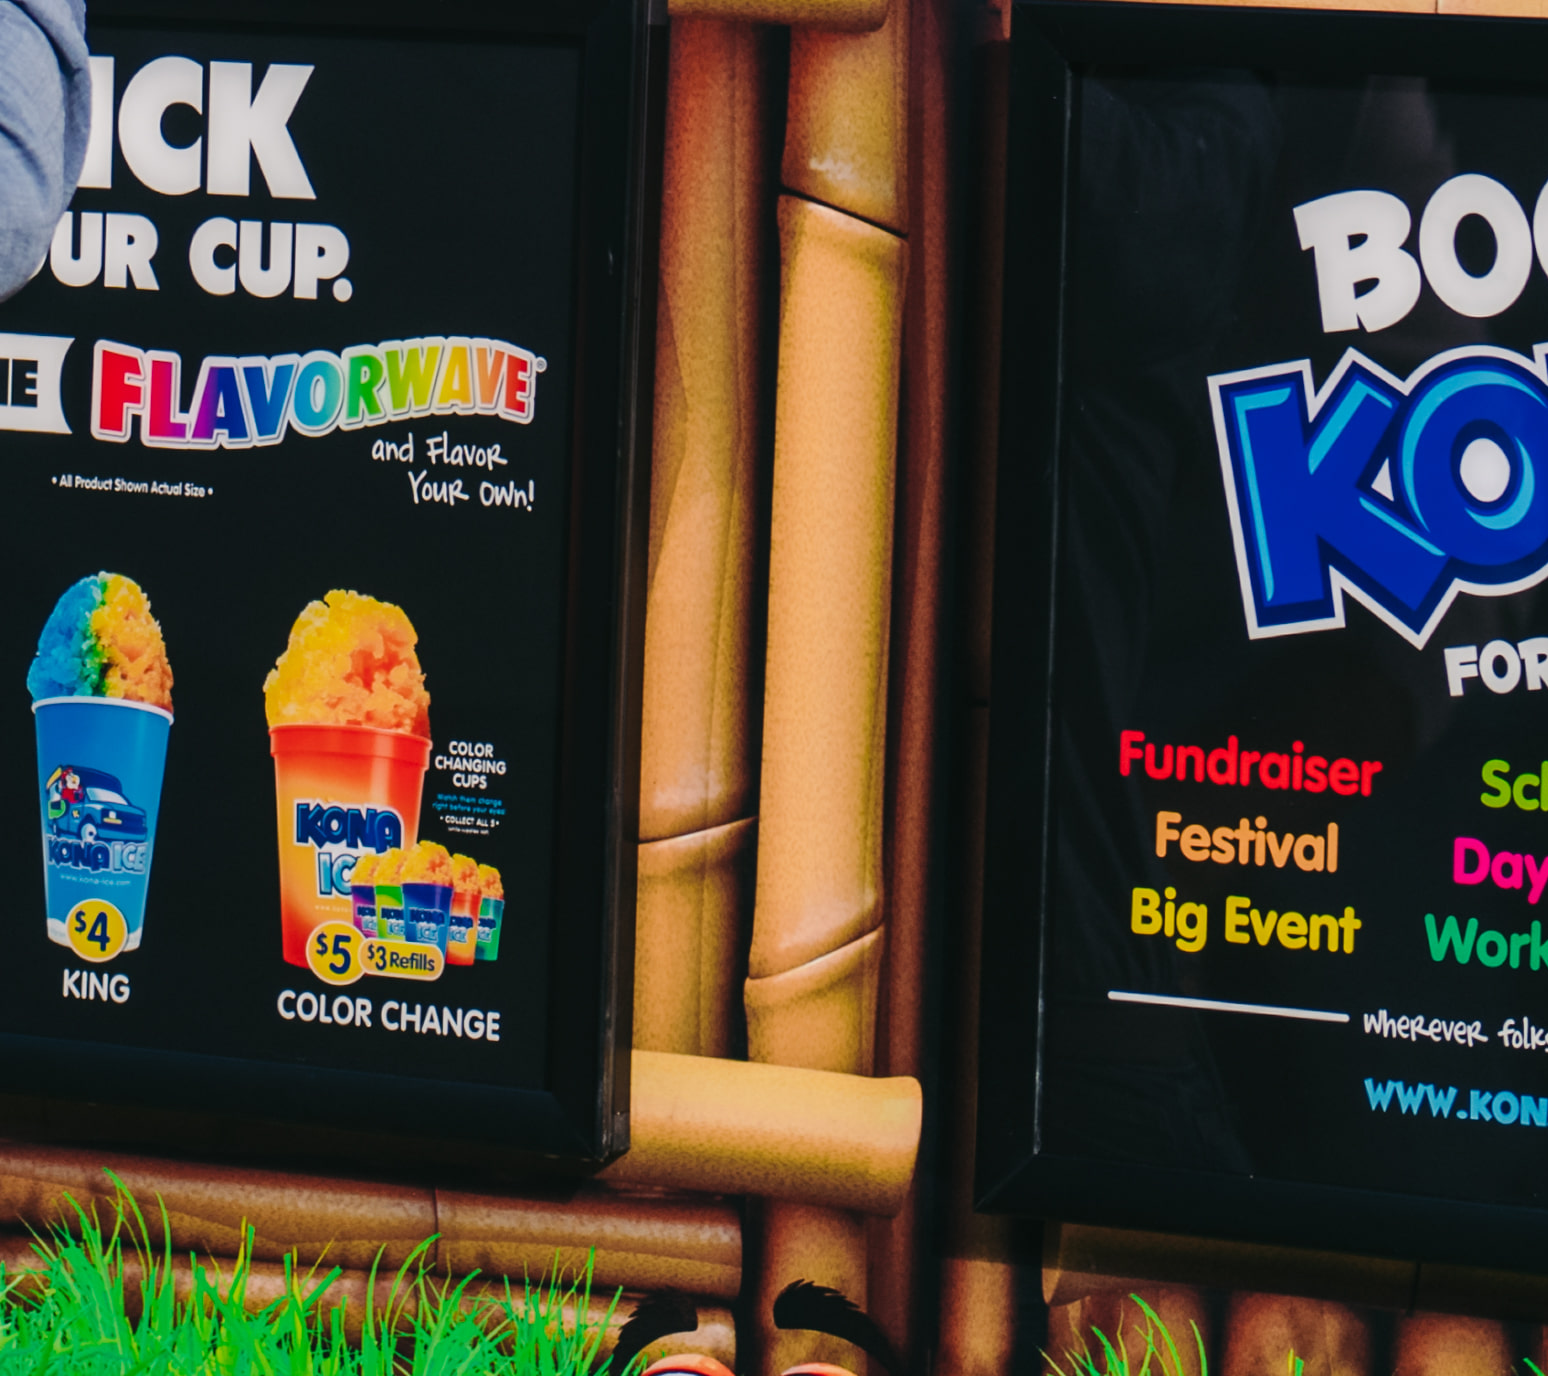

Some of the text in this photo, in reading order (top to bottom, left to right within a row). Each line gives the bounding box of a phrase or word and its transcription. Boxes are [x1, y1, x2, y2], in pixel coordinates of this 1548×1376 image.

[77, 55, 317, 200] ICK
[28, 211, 353, 303] UR CUP.
[93, 337, 535, 448] FLAVORWAVE
[371, 431, 414, 464] and
[59, 474, 206, 498] All Product Shown Actual Size
[434, 754, 507, 776] CHANGING
[448, 740, 494, 759] COLOR
[1119, 729, 1383, 797] Fundraiser
[452, 772, 488, 790] CUPS
[294, 798, 405, 855] KONA
[1155, 810, 1339, 873] Festival
[316, 850, 361, 898] IC
[74, 909, 111, 952] $4
[1130, 886, 1362, 954] Big Event
[316, 931, 352, 975] $5
[367, 943, 435, 972] $3 Refills
[62, 968, 131, 1003] KING
[276, 989, 501, 1042] COLOR CHANGE
